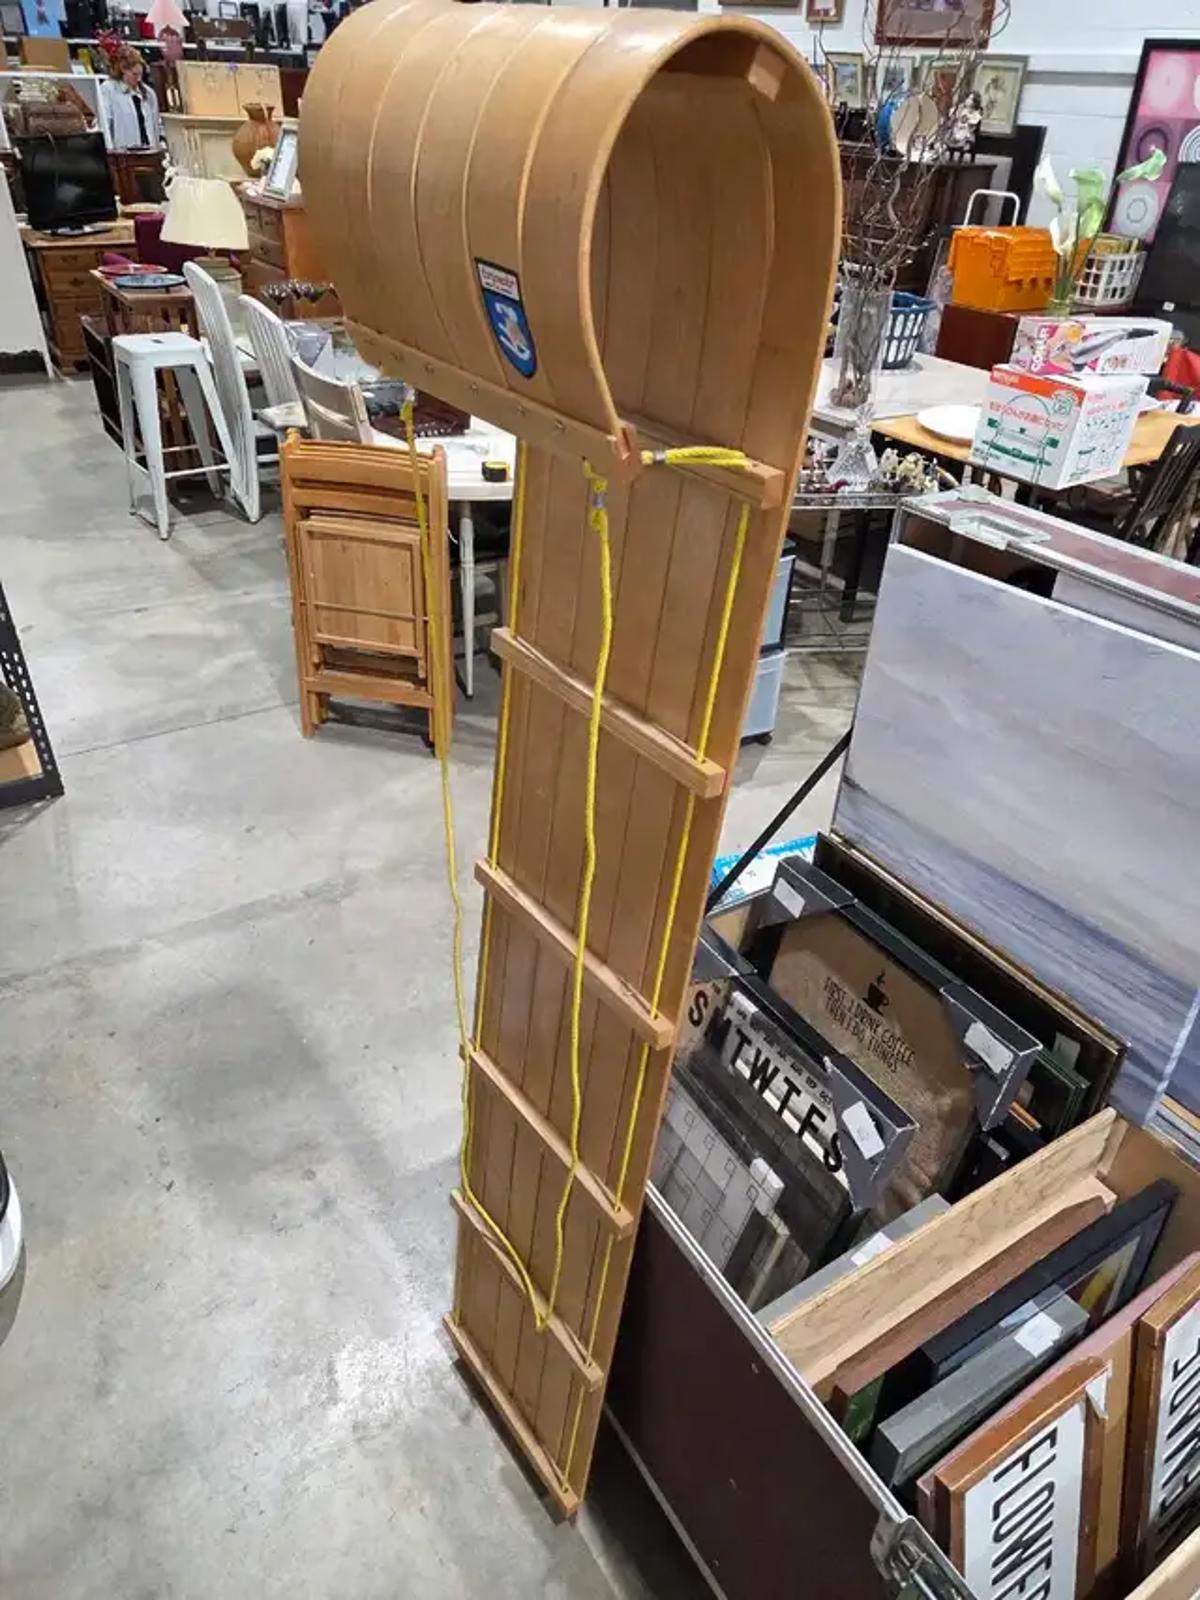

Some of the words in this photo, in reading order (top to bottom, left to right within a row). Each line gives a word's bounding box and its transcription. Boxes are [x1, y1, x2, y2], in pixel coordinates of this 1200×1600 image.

[867, 1036, 897, 1074] THINGS
[881, 1029, 915, 1067] COFFEE
[749, 1047, 780, 1095] W
